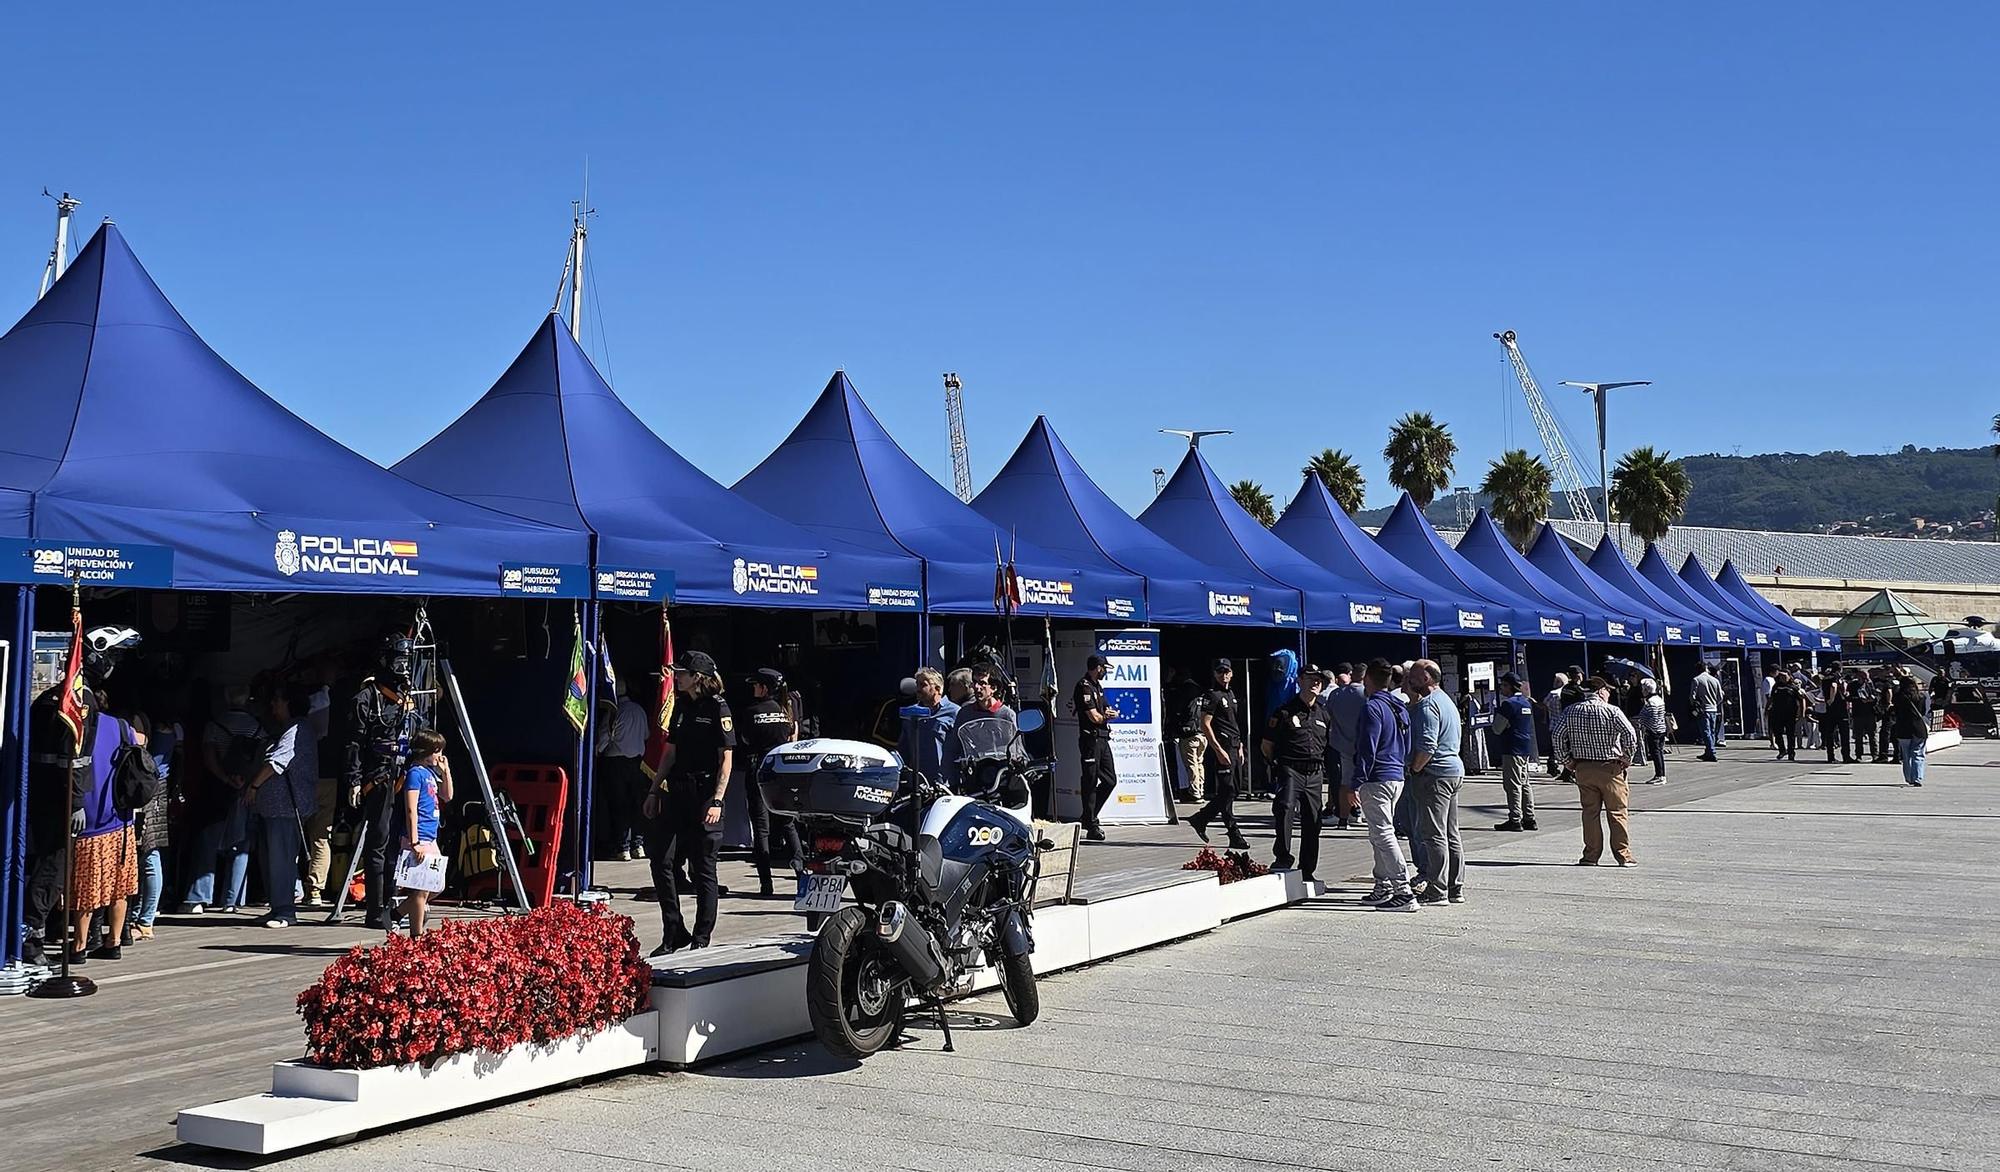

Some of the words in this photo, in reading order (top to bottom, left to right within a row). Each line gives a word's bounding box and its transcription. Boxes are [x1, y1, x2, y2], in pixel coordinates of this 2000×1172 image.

[301, 536, 395, 556] POLICIA
[34, 550, 64, 564] 200
[69, 547, 104, 557] UNIDAD
[107, 549, 120, 558] DE
[68, 559, 127, 569] PREVENCIÓN
[301, 556, 418, 575] NACIONAL
[68, 570, 114, 580] RACCIÓN
[504, 570, 522, 582] 200
[524, 567, 553, 576] SUBSUELO
[616, 571, 639, 579] BRIGADA
[639, 572, 656, 580] MÓVIL
[748, 563, 802, 579] POLICIA
[524, 576, 560, 585] PROTECCIÓN
[598, 573, 613, 585] 200
[616, 579, 636, 588] POLICÍA
[637, 580, 645, 588] EN
[523, 586, 557, 594] AMBIENTAL
[748, 578, 818, 594] NACIONAL
[1025, 579, 1063, 592] POLICIA
[615, 588, 650, 597] TRANSPORTE
[881, 588, 899, 596] UNIDAD
[900, 590, 919, 598] ESPECIAL
[1026, 591, 1073, 605] NACIONAL
[1215, 594, 1245, 605] POLICIA
[1216, 604, 1251, 616] NACIONAL
[854, 791, 890, 804] NACIONAL
[855, 785, 885, 798] POLICIA
[968, 826, 1004, 846] 200
[806, 893, 837, 908] 4111
